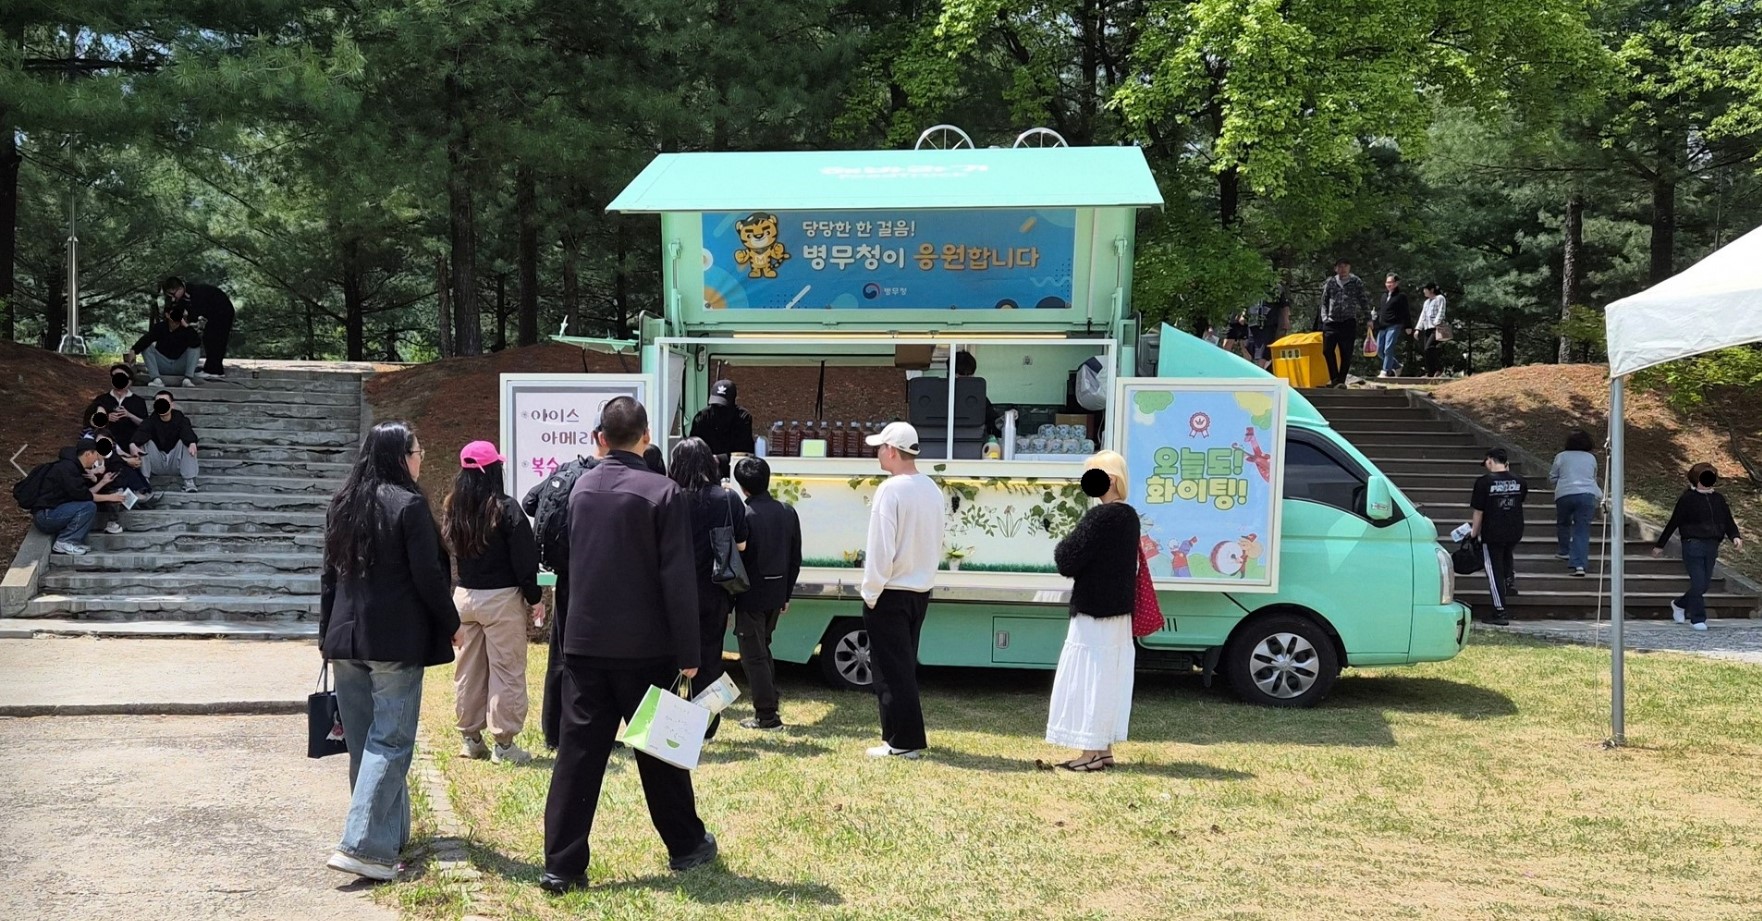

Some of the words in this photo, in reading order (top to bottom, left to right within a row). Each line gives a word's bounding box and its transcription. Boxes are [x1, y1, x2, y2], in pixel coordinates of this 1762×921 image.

[802, 221, 852, 237] 당당한
[856, 221, 873, 237] 한
[877, 220, 916, 237] 걸음!
[803, 243, 905, 270] 병무청이
[913, 243, 1040, 270] 응원합니다
[883, 287, 908, 296] 병무청
[531, 408, 580, 423] 아이스
[541, 431, 595, 446] 아메리
[1153, 446, 1245, 480] 오늘도!
[1145, 475, 1249, 511] 화이팅!
